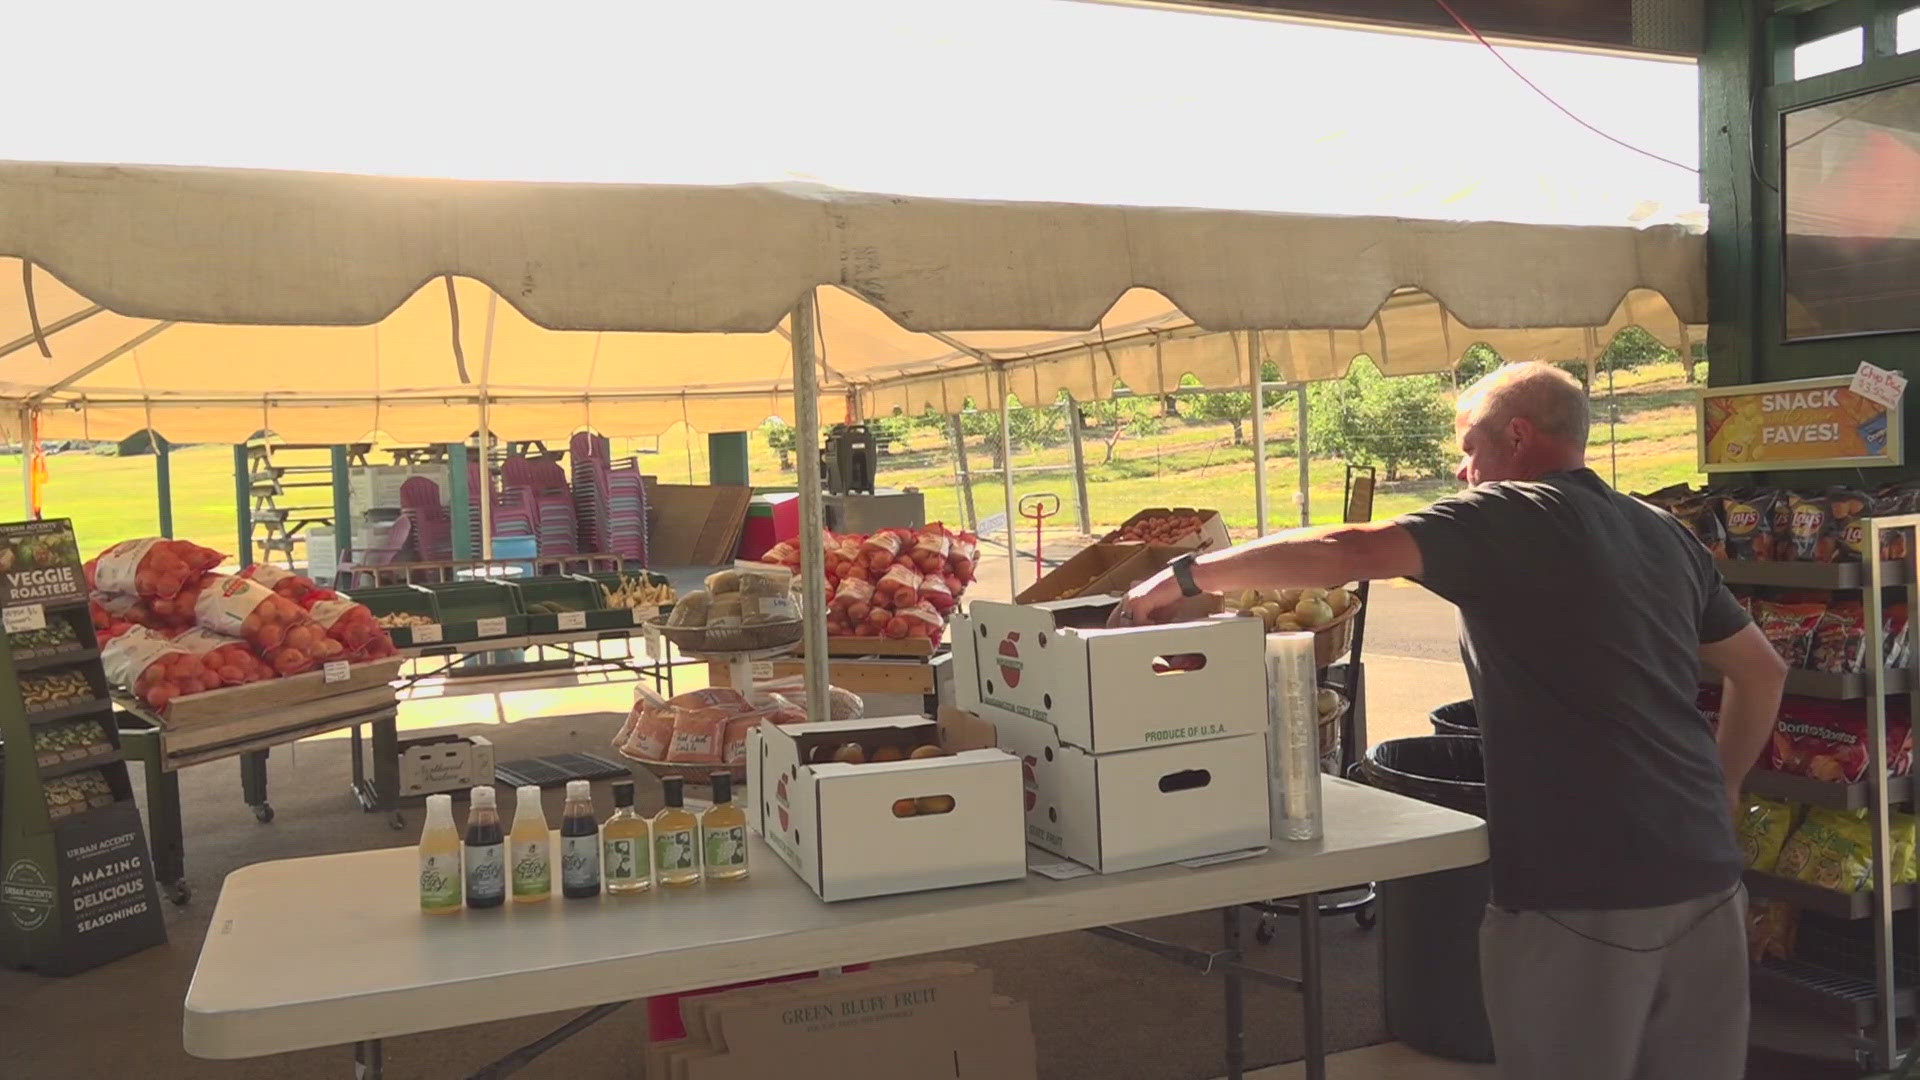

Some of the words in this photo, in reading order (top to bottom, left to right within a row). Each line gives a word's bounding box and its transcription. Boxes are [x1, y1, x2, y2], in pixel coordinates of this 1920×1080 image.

[1762, 389, 1839, 412] SNACK
[1762, 422, 1839, 444] FAVES!
[6, 566, 74, 588] VEGGIE
[10, 581, 78, 600] ROASTERS
[1144, 727, 1186, 742] PRODUCE
[1187, 726, 1200, 738] OF
[1201, 723, 1228, 736] U.S.A.
[67, 843, 98, 859] URBAN
[99, 832, 135, 849] ACCENTS
[71, 856, 141, 888] AMAZING
[73, 878, 144, 912] DELICIOUS
[77, 901, 148, 933] SEASONINGS
[782, 1003, 833, 1026] GREEN
[841, 995, 888, 1016] BLUFF
[894, 987, 938, 1008] FRUIT
